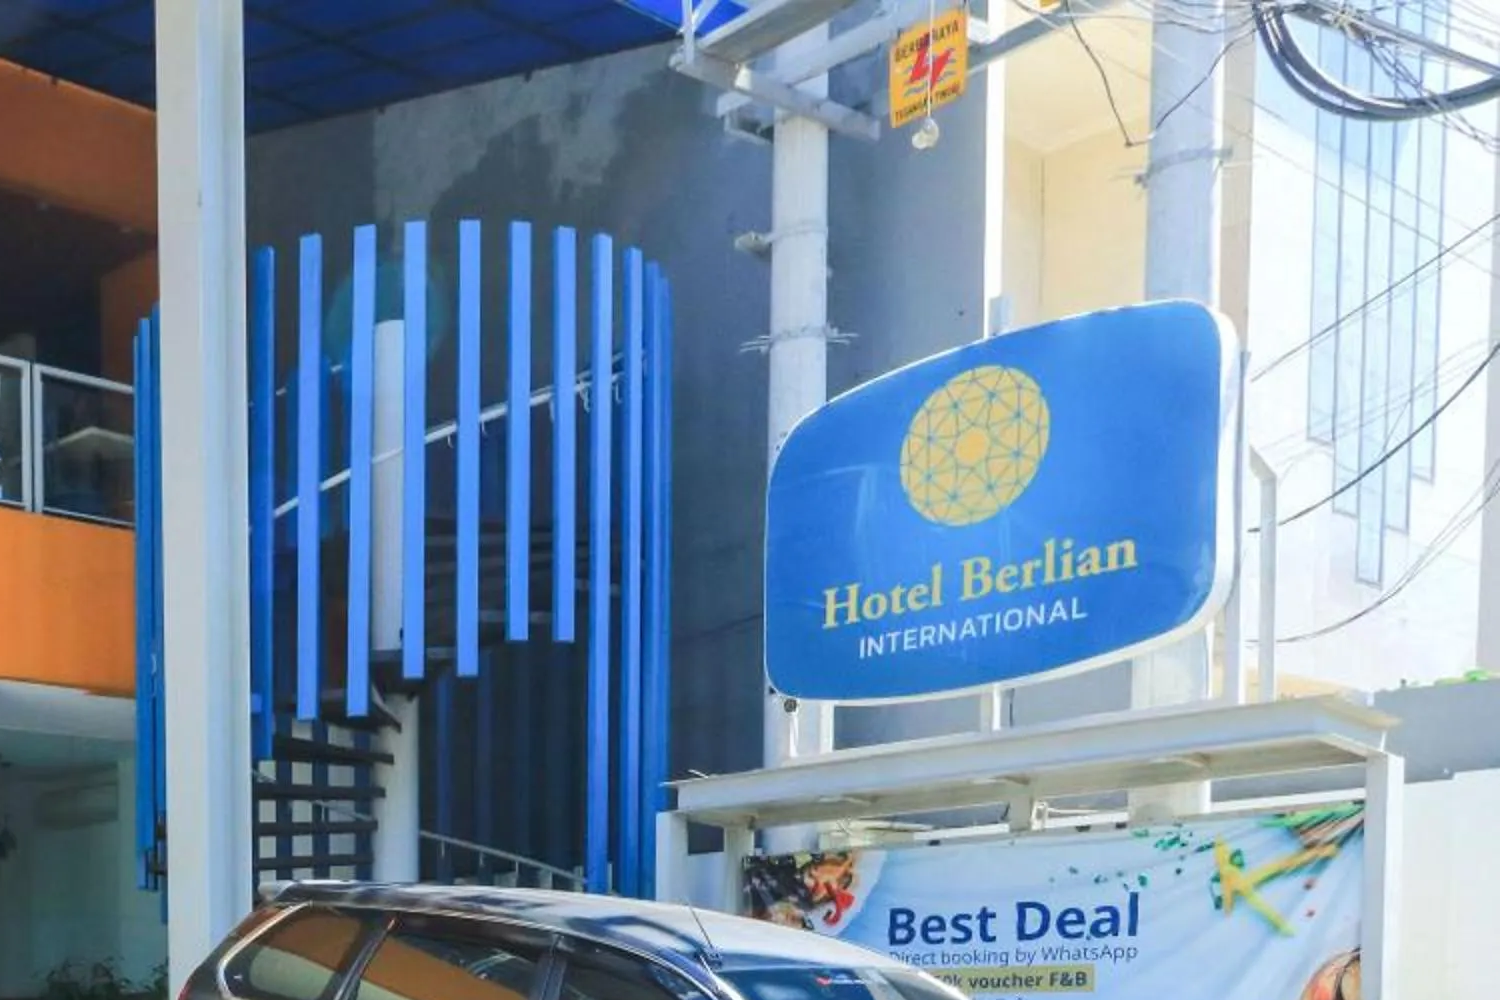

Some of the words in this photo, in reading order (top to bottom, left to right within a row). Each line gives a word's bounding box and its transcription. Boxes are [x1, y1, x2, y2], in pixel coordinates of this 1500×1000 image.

[822, 561, 943, 629] Hotel
[959, 537, 1140, 601] Berlian
[858, 597, 1088, 659] INTERNATIONAL
[888, 906, 997, 946] Best
[1016, 892, 1140, 942] Deal
[941, 948, 1010, 967] booking
[1015, 947, 1037, 966] by
[1041, 944, 1139, 965] WhatsApp
[968, 971, 1045, 989] voucher
[1049, 970, 1088, 987] F&B
